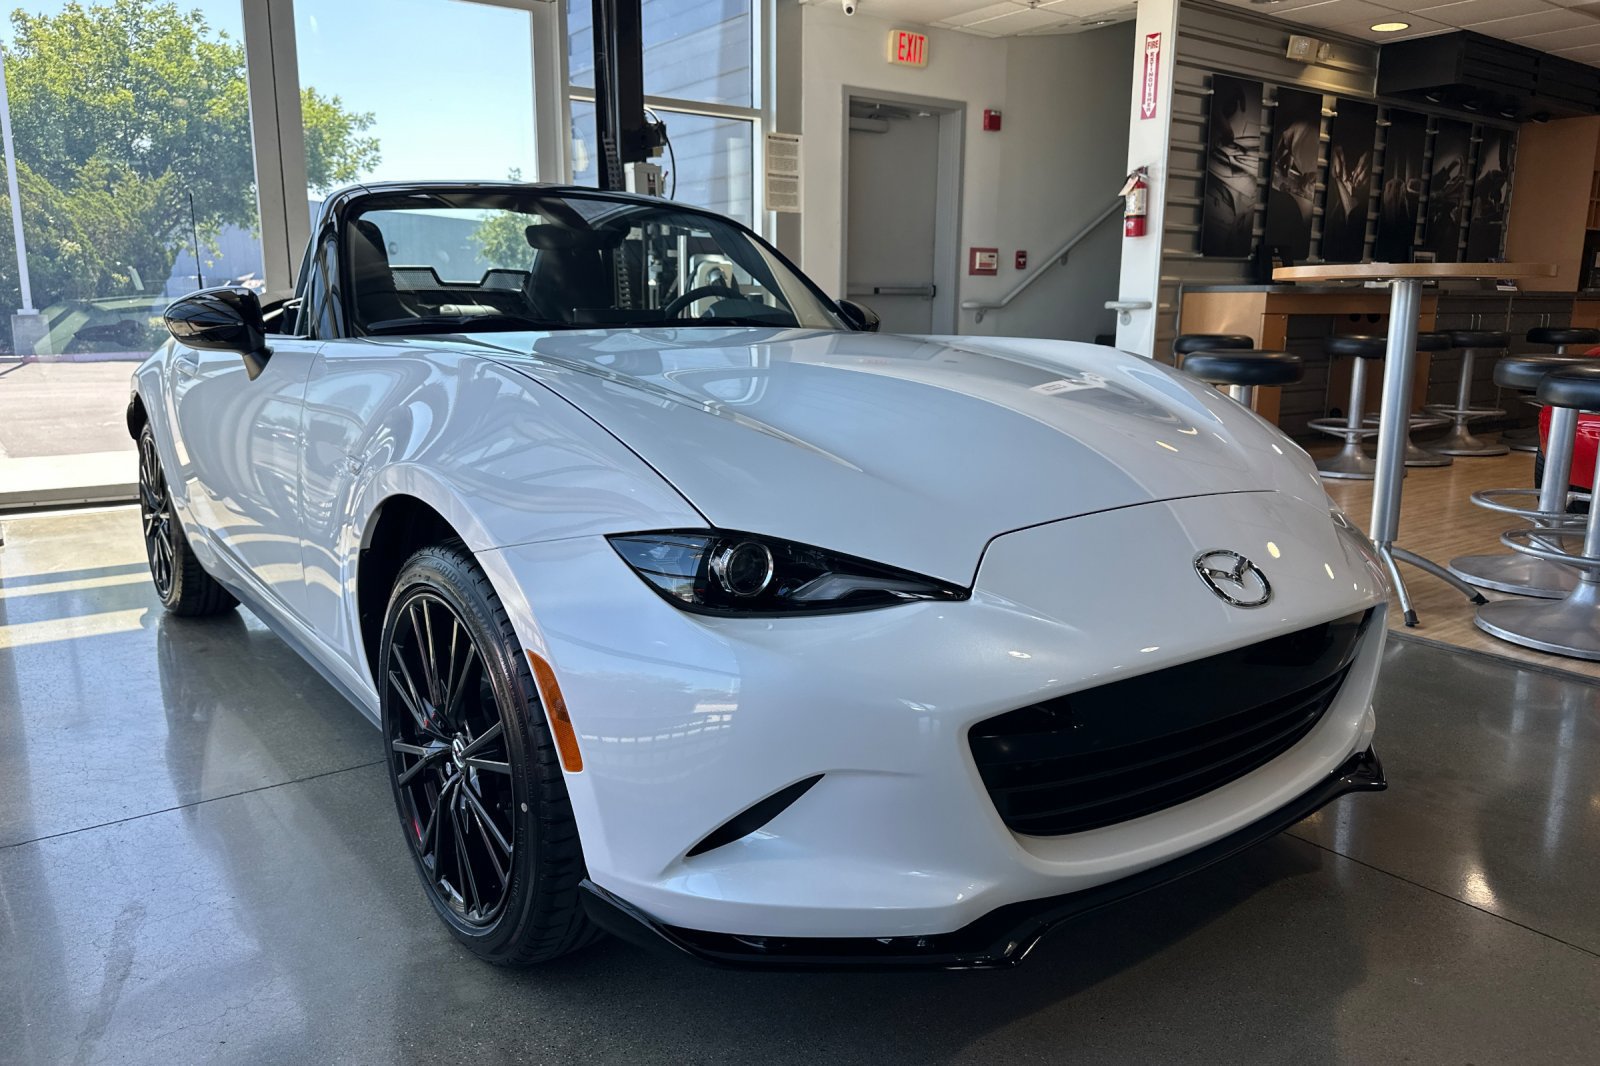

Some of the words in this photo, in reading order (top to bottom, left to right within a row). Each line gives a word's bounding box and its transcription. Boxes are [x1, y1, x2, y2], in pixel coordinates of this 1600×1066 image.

[898, 32, 925, 64] EXIT
[1147, 40, 1159, 50] FIRE
[1146, 52, 1155, 112] EXTINGUISHER
